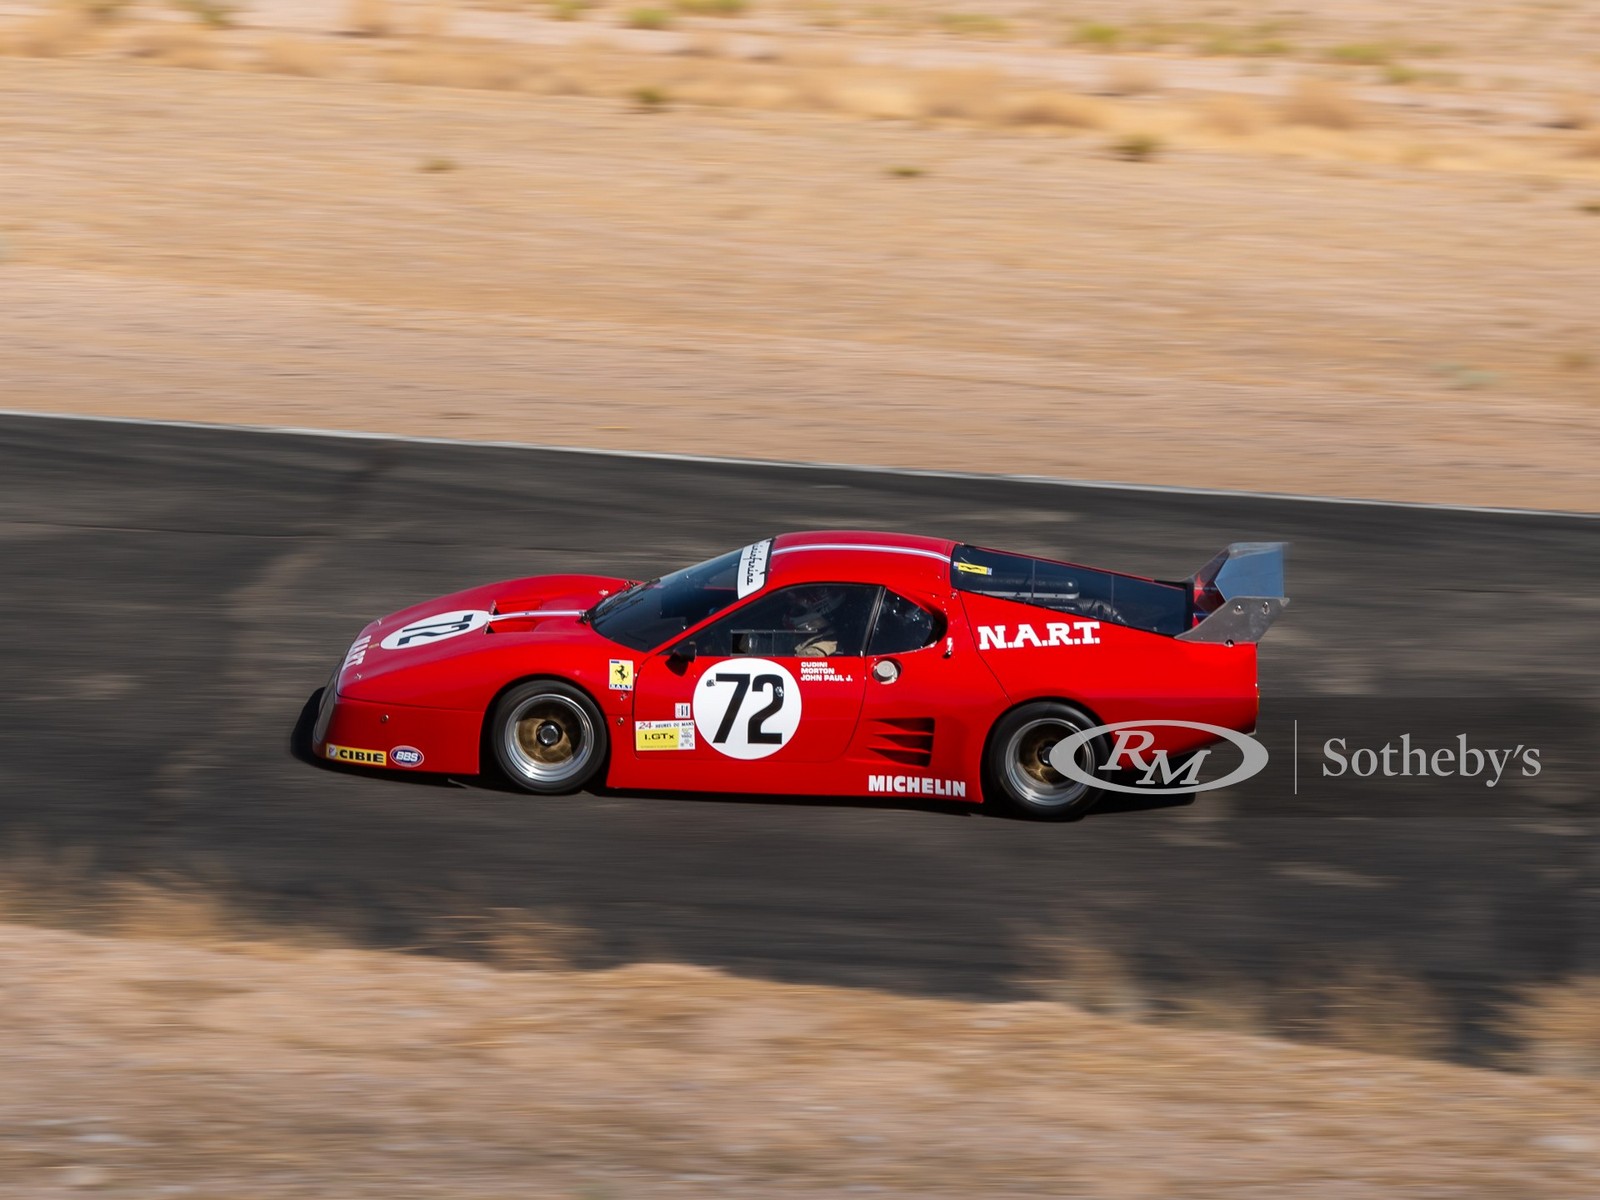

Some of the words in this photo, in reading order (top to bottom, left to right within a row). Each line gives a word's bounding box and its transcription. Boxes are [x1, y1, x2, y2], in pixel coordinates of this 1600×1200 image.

[396, 613, 474, 646] 72
[977, 621, 1101, 651] N.A.R.T.
[800, 674, 822, 682] JOHN
[823, 674, 845, 682] PAUL
[712, 673, 784, 744] 72
[396, 751, 419, 762] BBS
[868, 774, 966, 797] MICHELIN
